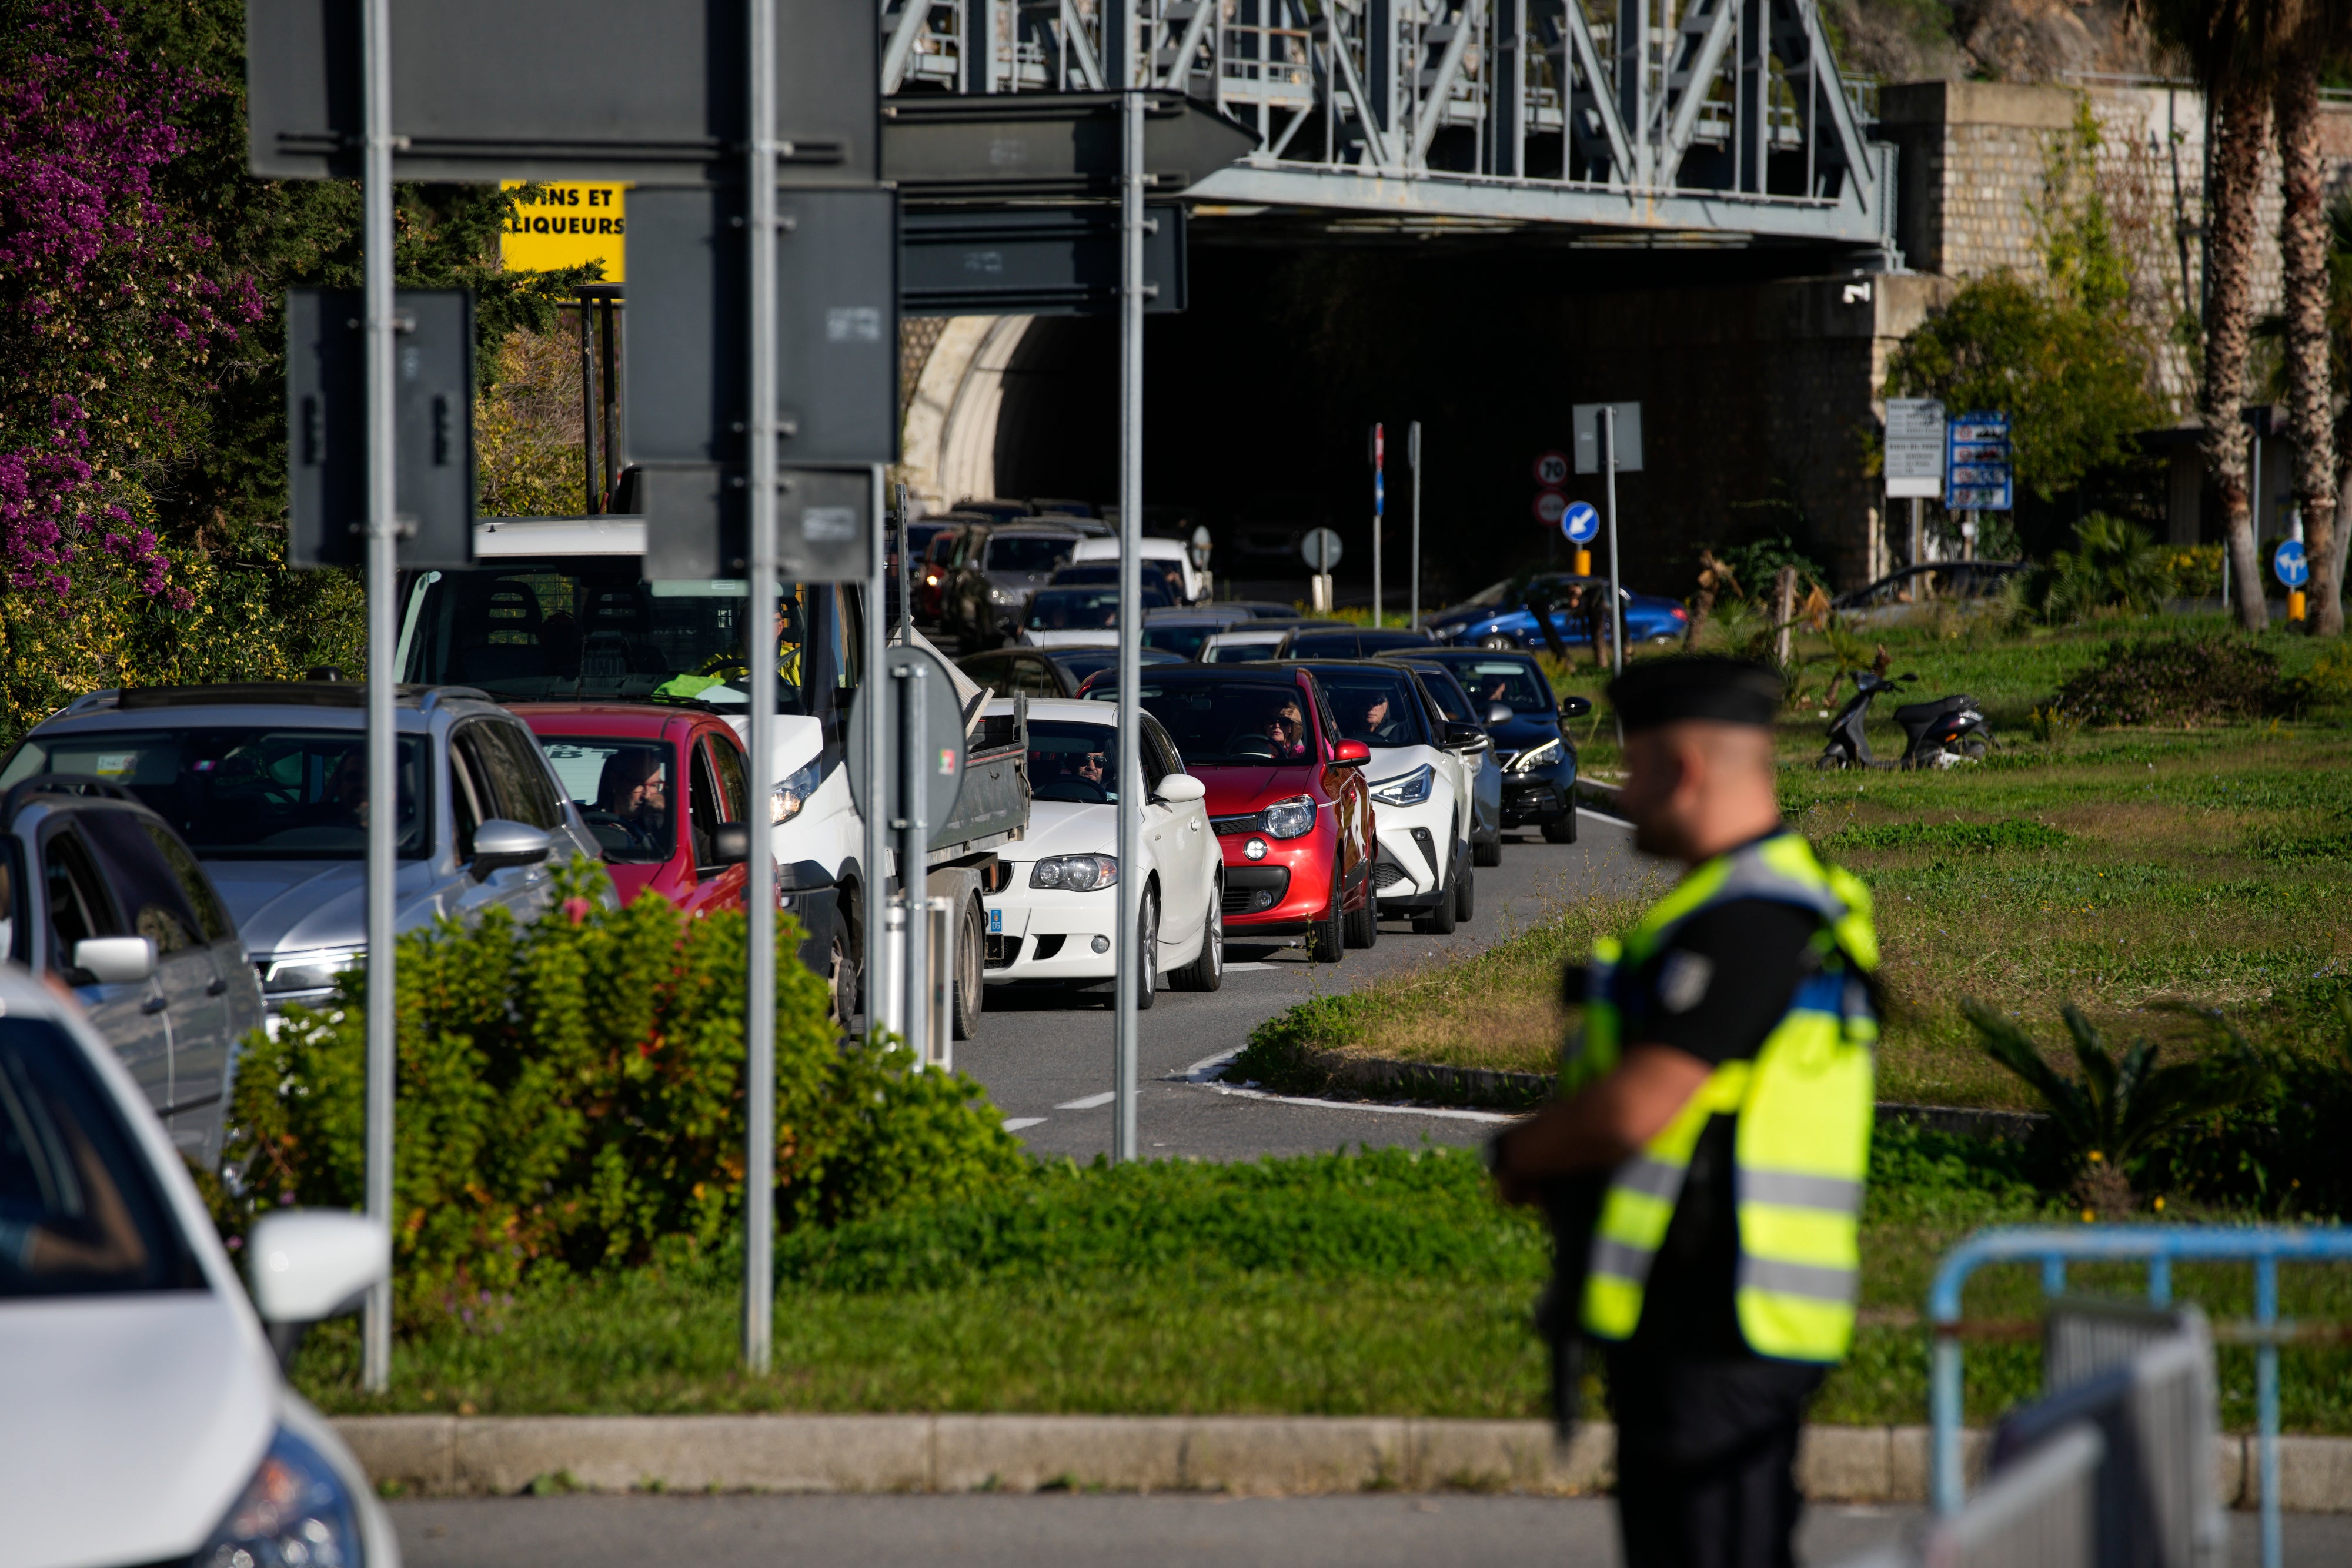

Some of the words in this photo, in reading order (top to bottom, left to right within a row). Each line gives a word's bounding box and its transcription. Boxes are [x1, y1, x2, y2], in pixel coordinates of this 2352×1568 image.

[589, 189, 612, 206] ET
[511, 217, 625, 234] LIQUEURS
[1545, 460, 1563, 478] 70
[992, 921, 1000, 930] 06
